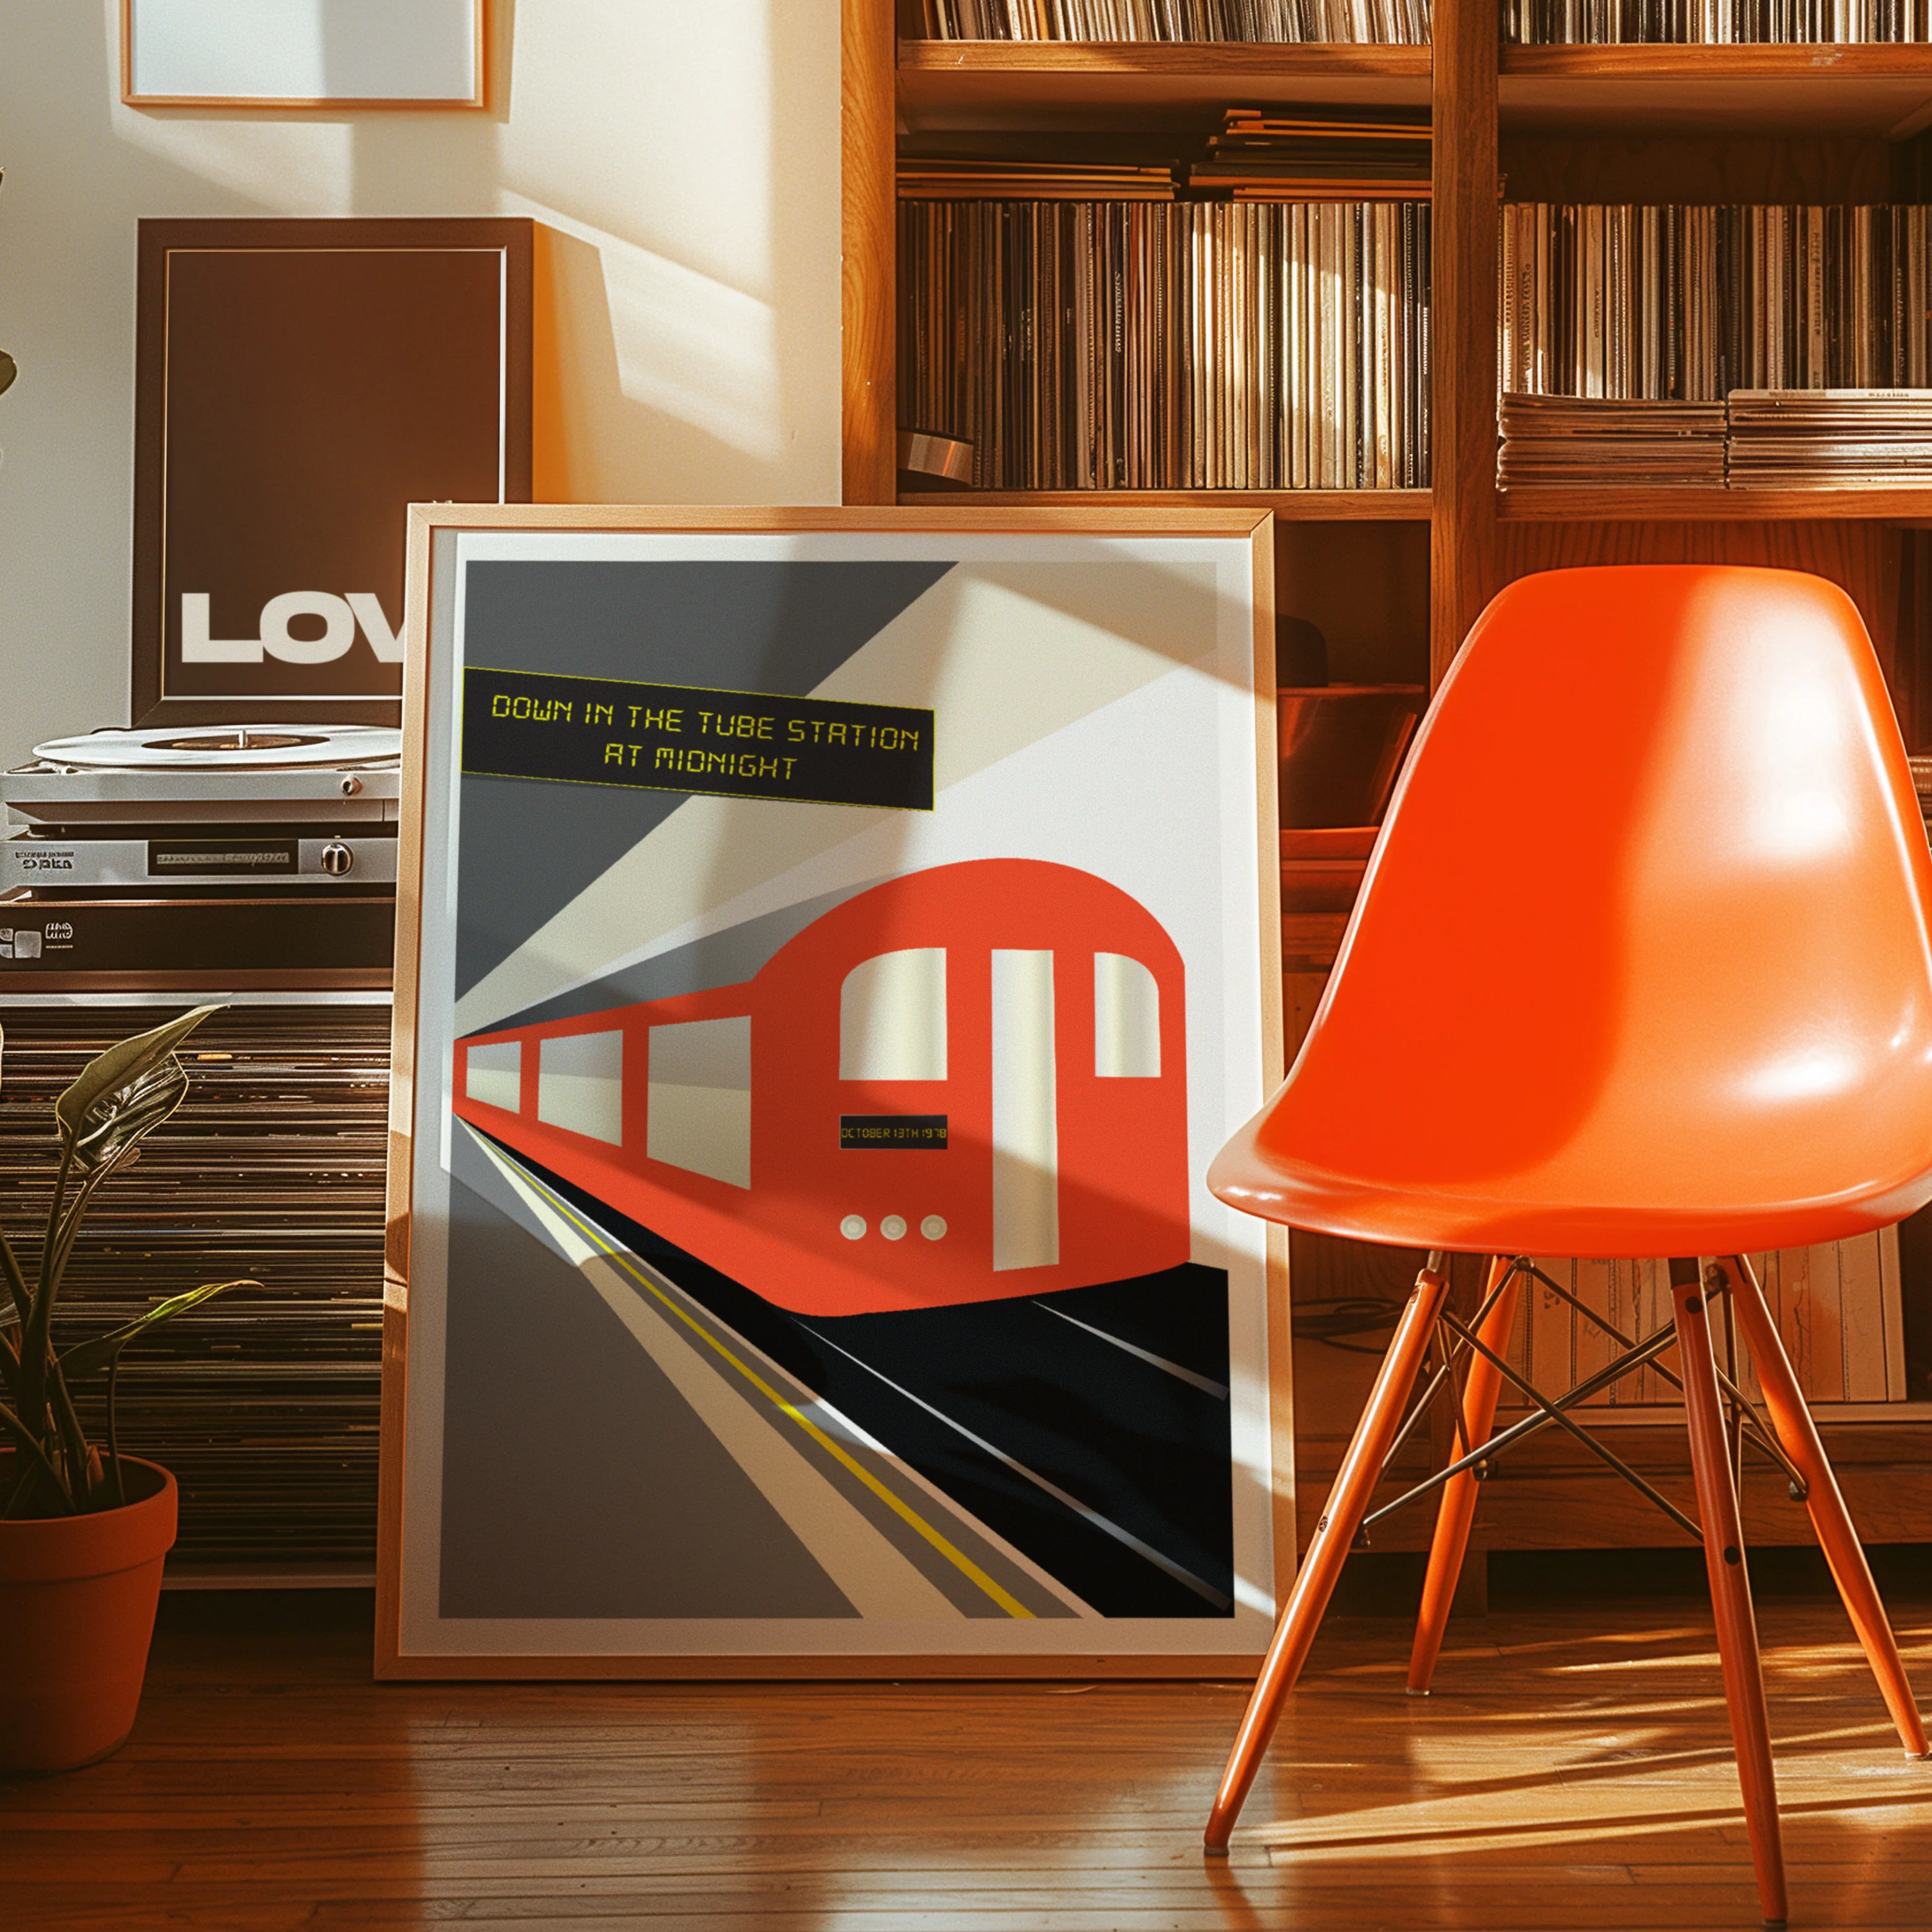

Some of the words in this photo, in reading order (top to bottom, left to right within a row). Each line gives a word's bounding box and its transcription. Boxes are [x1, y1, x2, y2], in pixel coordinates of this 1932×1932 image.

[491, 694, 573, 723] DOWN
[585, 703, 614, 726] IN
[628, 705, 685, 733] THE
[698, 711, 775, 740] TUBE
[788, 719, 920, 752] STATION
[604, 743, 643, 767] AT
[654, 747, 798, 781] MIDNIGHT
[841, 1128, 891, 1139] OCTOBER
[893, 1128, 919, 1139] 13TH
[921, 1128, 947, 1139] 1978
